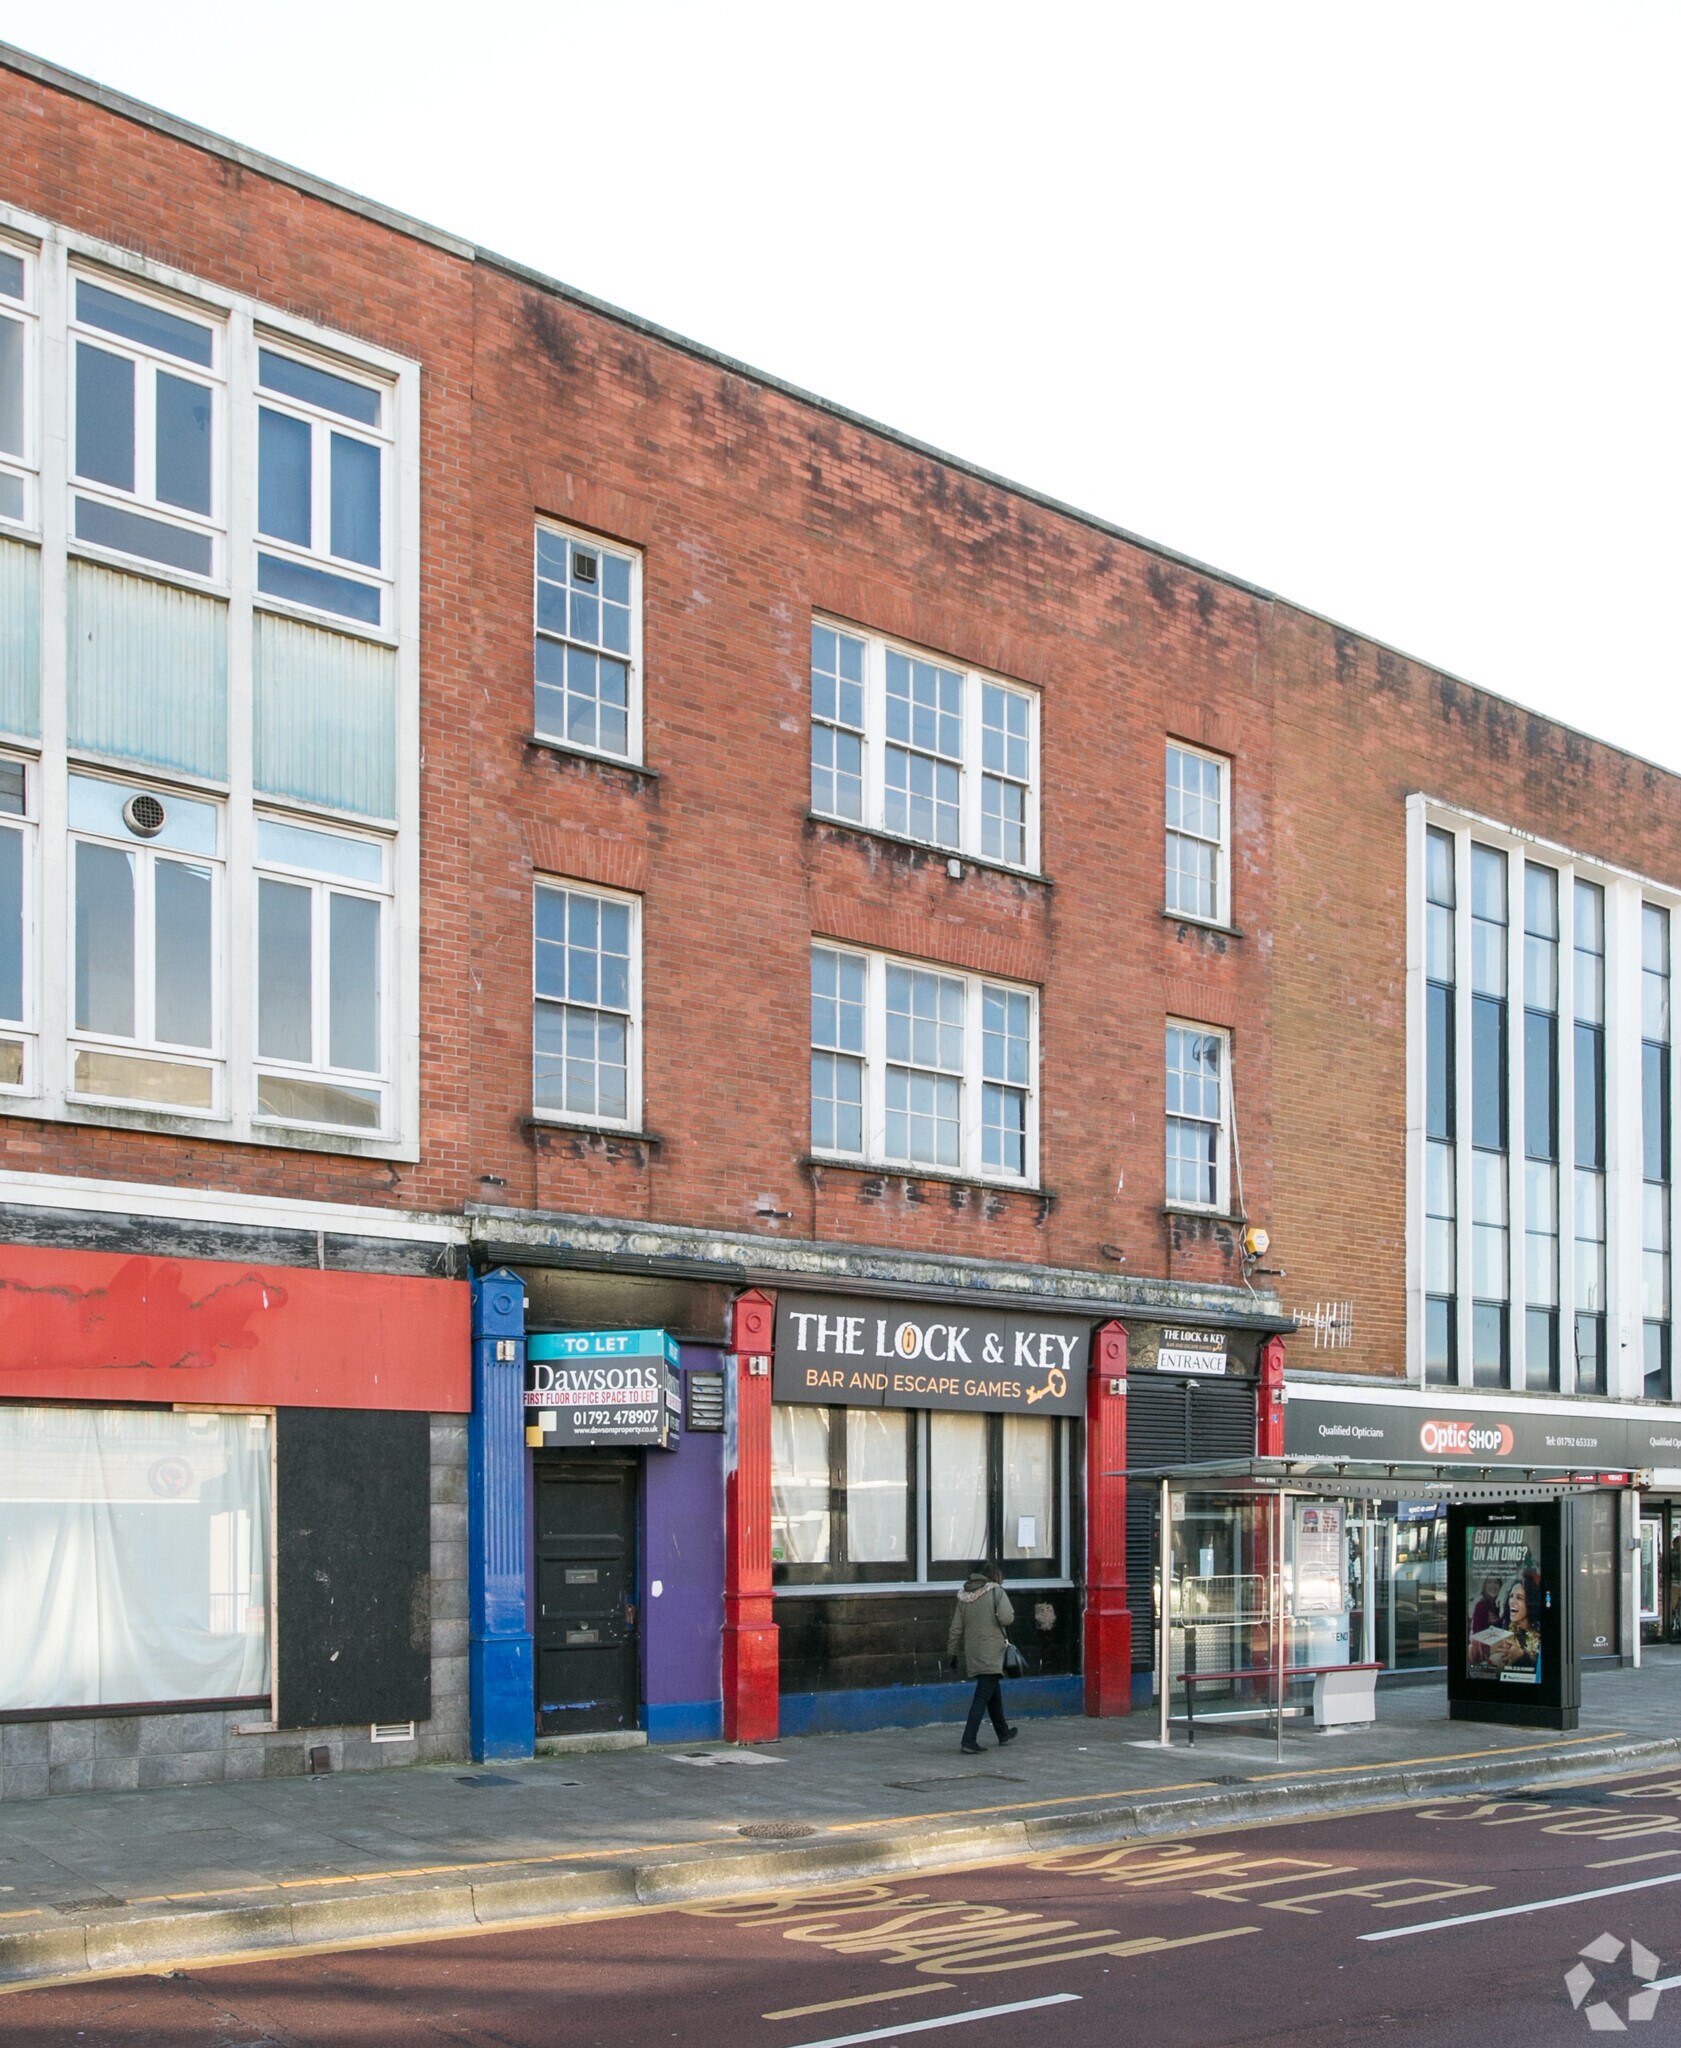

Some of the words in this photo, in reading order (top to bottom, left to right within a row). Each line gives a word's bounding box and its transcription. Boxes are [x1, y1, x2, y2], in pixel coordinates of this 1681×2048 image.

[564, 1338, 590, 1352] TO
[595, 1336, 629, 1352] LET
[789, 1311, 866, 1356] THE
[875, 1319, 973, 1364] LOCK
[982, 1332, 1005, 1364] &
[1013, 1331, 1080, 1370] KEY
[1164, 1329, 1180, 1340] THE
[1180, 1330, 1202, 1342] LOCK
[1203, 1333, 1209, 1342] &
[1210, 1333, 1226, 1344] KEY
[1161, 1353, 1224, 1371] ENTRANCE
[805, 1369, 845, 1388] BAR
[849, 1372, 889, 1391] AND
[893, 1375, 960, 1396] ESCAPE
[964, 1379, 1022, 1398] GAMES
[523, 1392, 545, 1405] FIRST
[546, 1391, 570, 1405] FLOOR
[572, 1391, 599, 1404] OFFICE
[601, 1390, 627, 1404] SPACE
[629, 1390, 639, 1403] TO
[641, 1390, 655, 1403] LET
[573, 1410, 611, 1426] 01792
[613, 1409, 659, 1425] 478907
[573, 1425, 659, 1435] www.dawsonsproperty.co.uk
[1318, 1424, 1351, 1437] Qualified
[1351, 1425, 1384, 1440] Opticians
[1420, 1423, 1467, 1454] Optic
[1467, 1429, 1502, 1450] SHOP
[1556, 1436, 1575, 1447] 01792
[1649, 1437, 1673, 1448] Qualified
[1475, 1529, 1492, 1544] GOT
[1492, 1529, 1506, 1544] AN
[1507, 1529, 1524, 1544] IOU
[1472, 1546, 1486, 1561] ON
[1487, 1546, 1500, 1561] AN
[1501, 1545, 1528, 1561] OMG?
